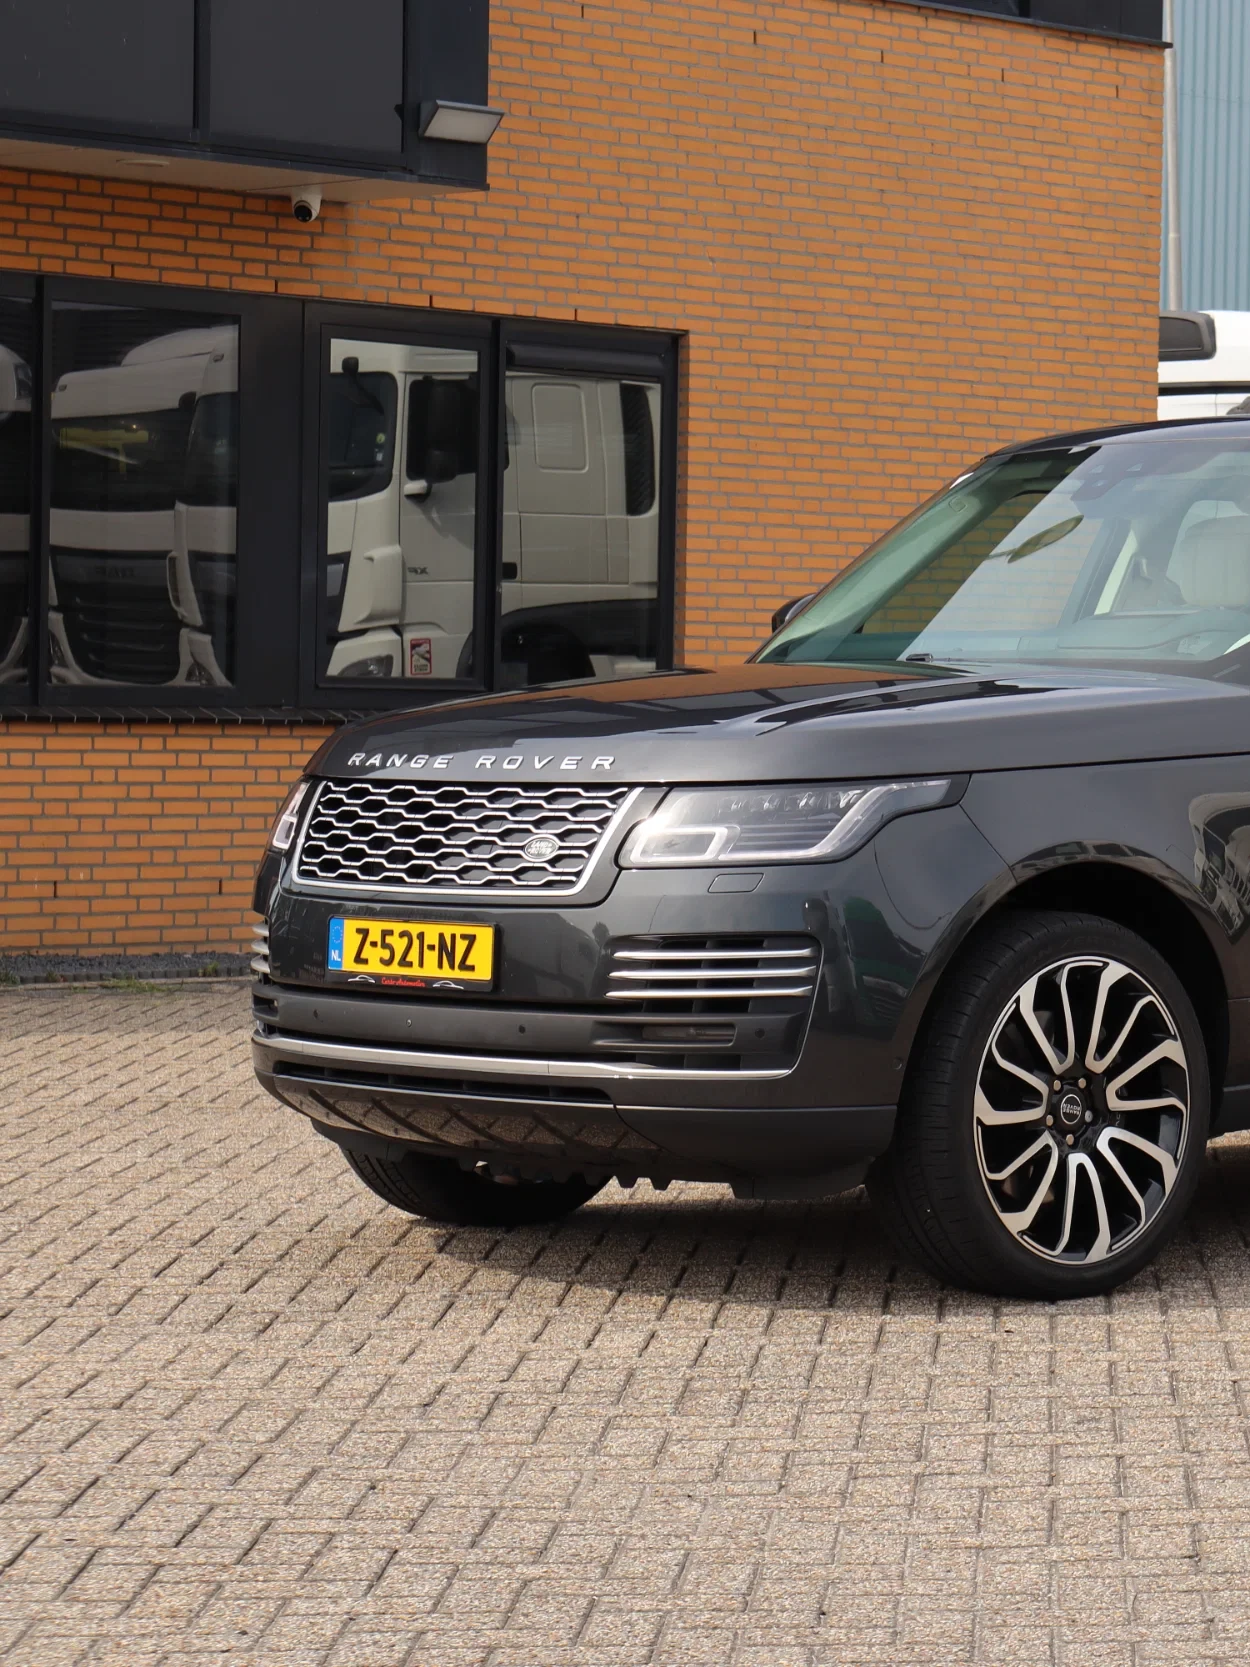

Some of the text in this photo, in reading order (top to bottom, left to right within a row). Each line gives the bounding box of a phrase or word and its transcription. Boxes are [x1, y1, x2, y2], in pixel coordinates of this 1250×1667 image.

[347, 752, 616, 770] RANGE ROVER
[331, 949, 342, 962] NL
[353, 927, 477, 972] Z-521-NZ
